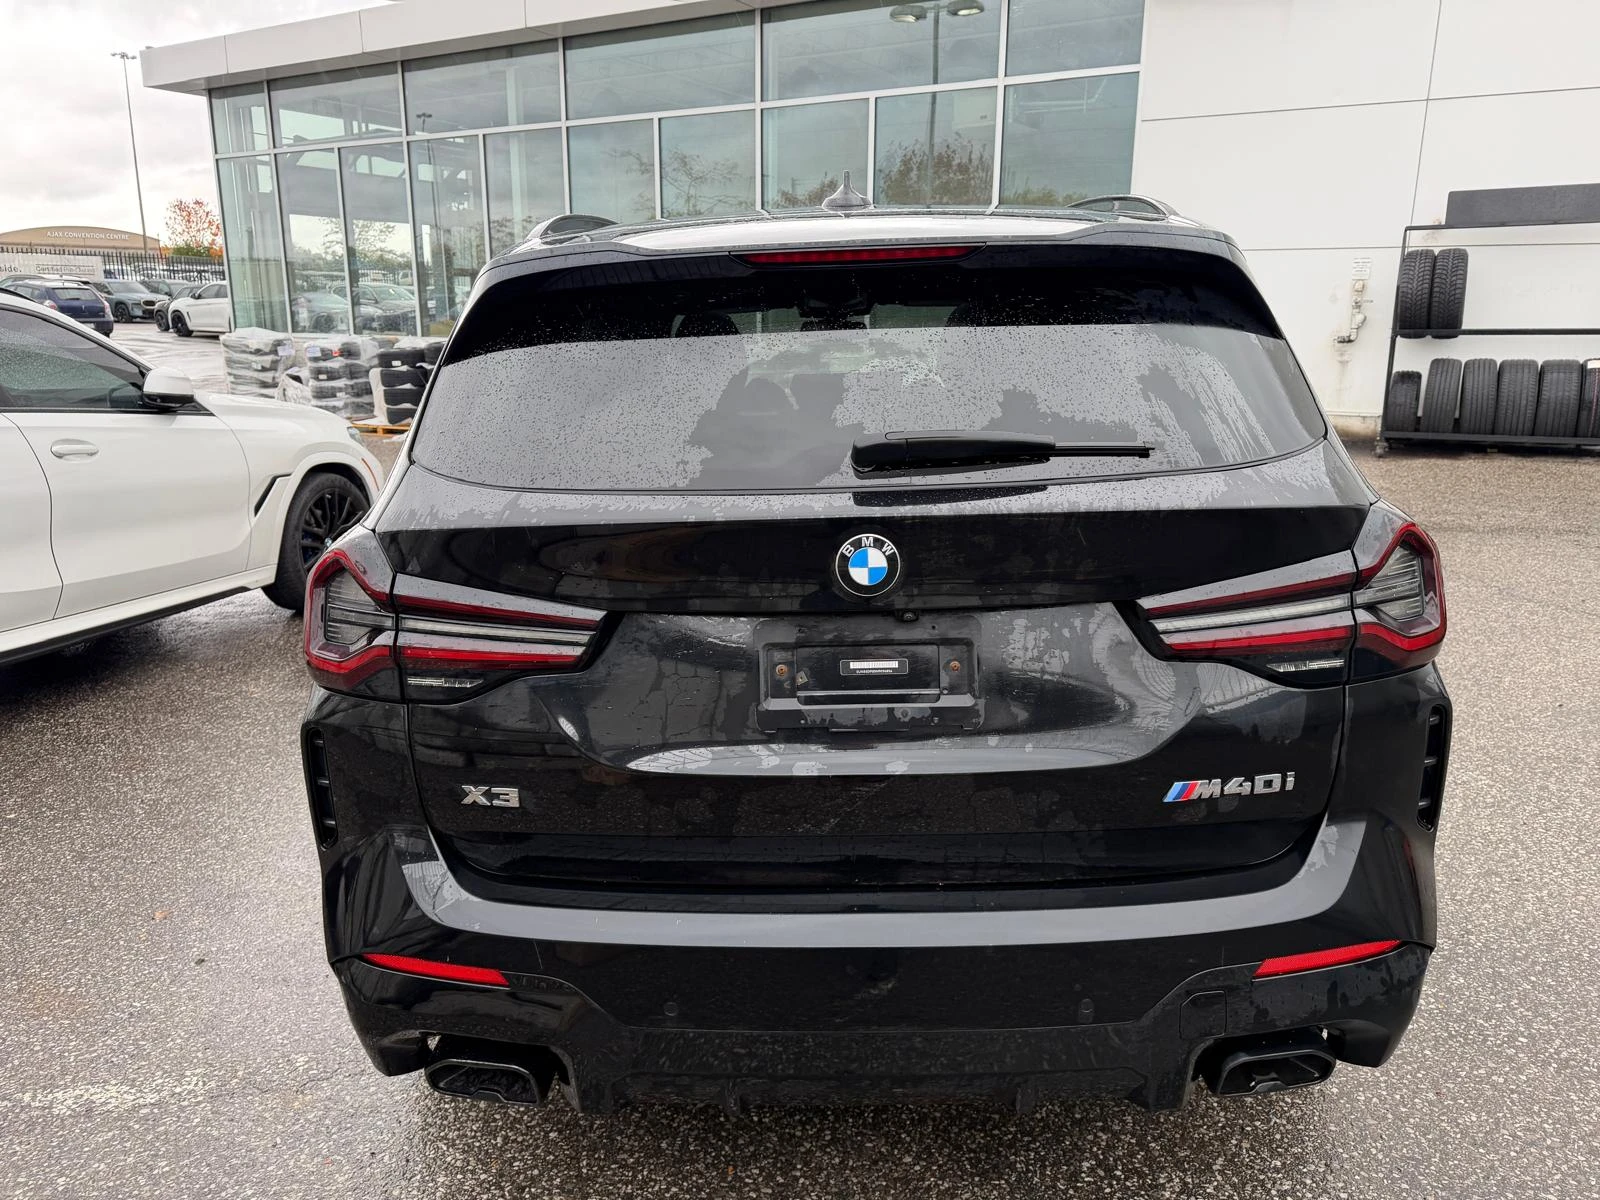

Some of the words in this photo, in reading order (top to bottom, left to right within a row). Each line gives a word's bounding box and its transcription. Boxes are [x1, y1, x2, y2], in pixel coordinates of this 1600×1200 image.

[64, 231, 105, 239] CONVENTION
[841, 536, 895, 558] BMW
[460, 785, 520, 808] X3
